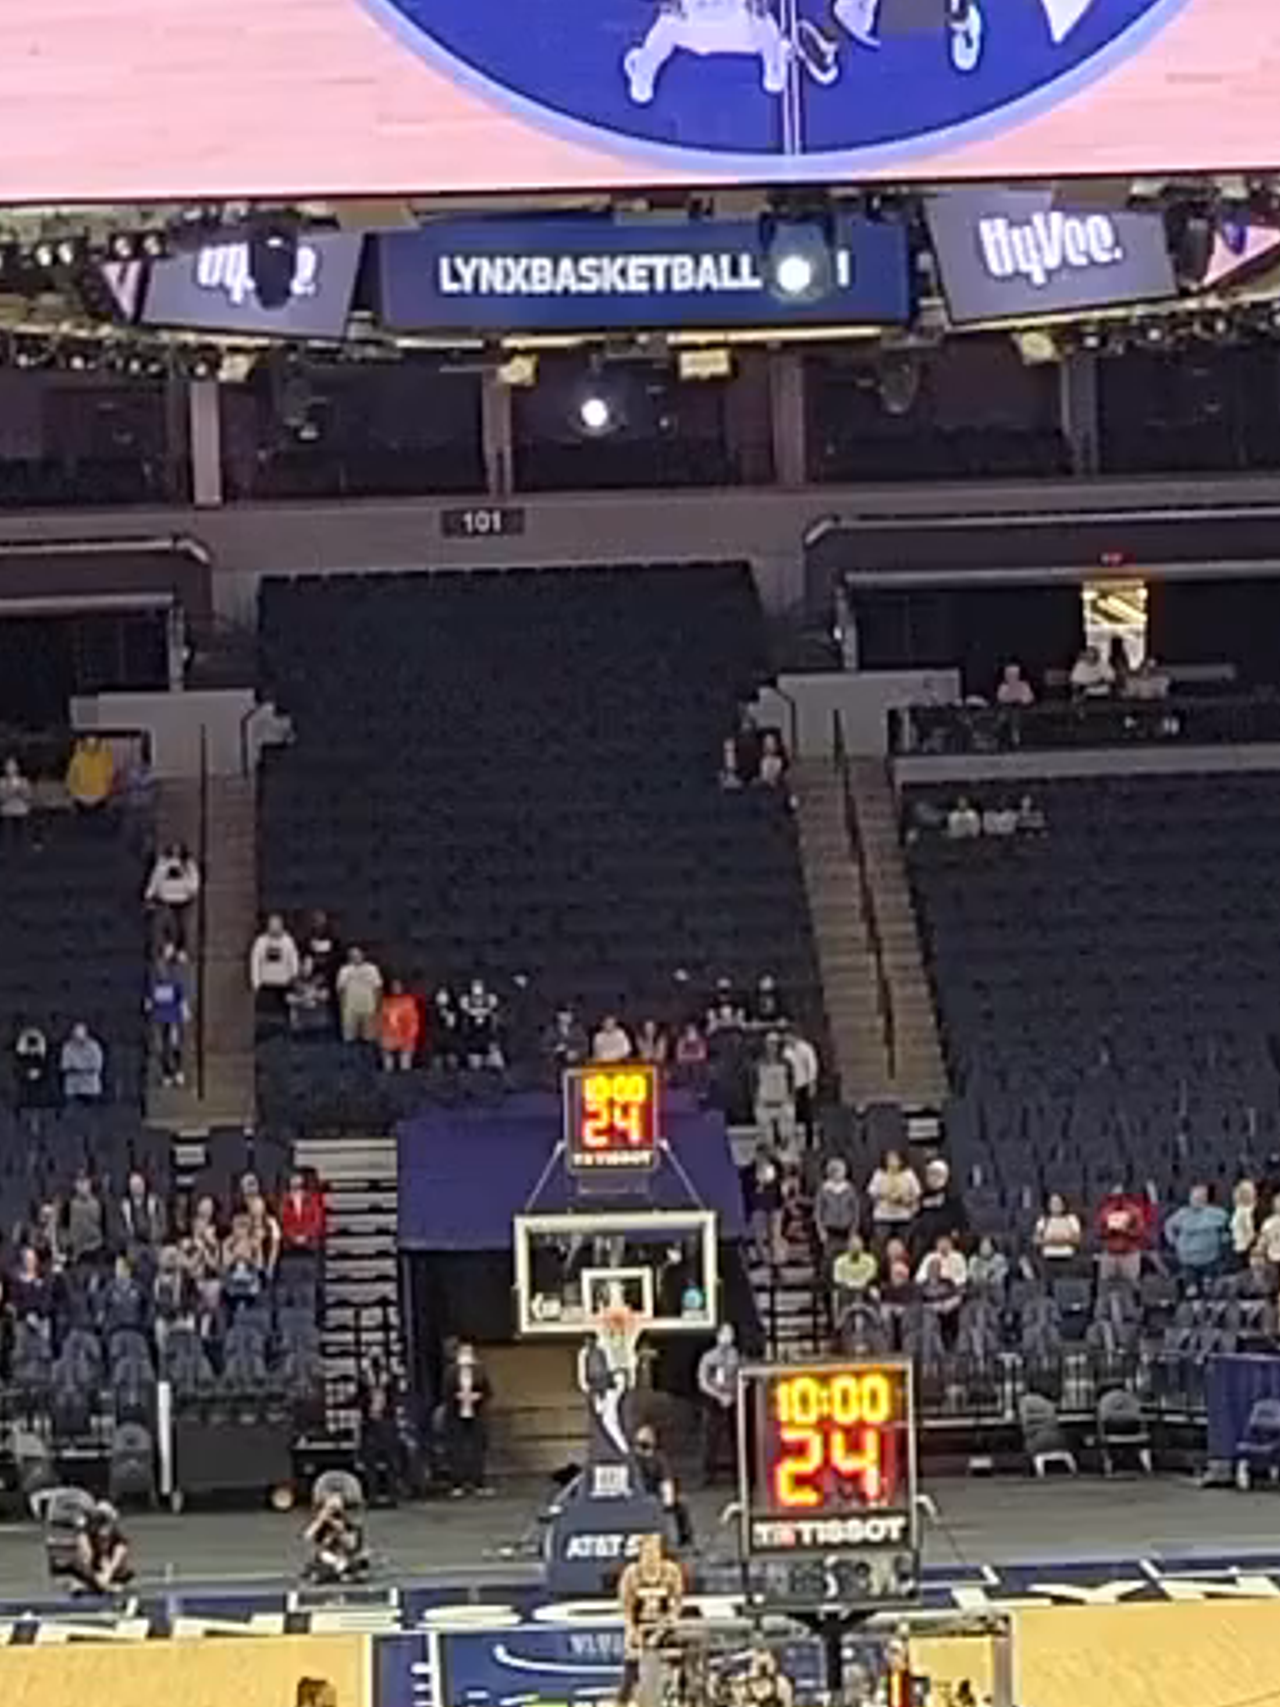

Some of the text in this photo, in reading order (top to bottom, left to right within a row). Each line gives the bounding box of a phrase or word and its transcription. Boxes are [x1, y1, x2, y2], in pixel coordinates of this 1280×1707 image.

[439, 253, 762, 294] LYNXBASKETBALL
[462, 510, 502, 533] 101
[584, 1075, 647, 1101] 10:00
[582, 1102, 641, 1147] 24
[776, 1373, 890, 1424] 10:00
[776, 1425, 882, 1507] 24
[567, 1534, 624, 1559] AT&T
[797, 1516, 907, 1546] TISSOT
